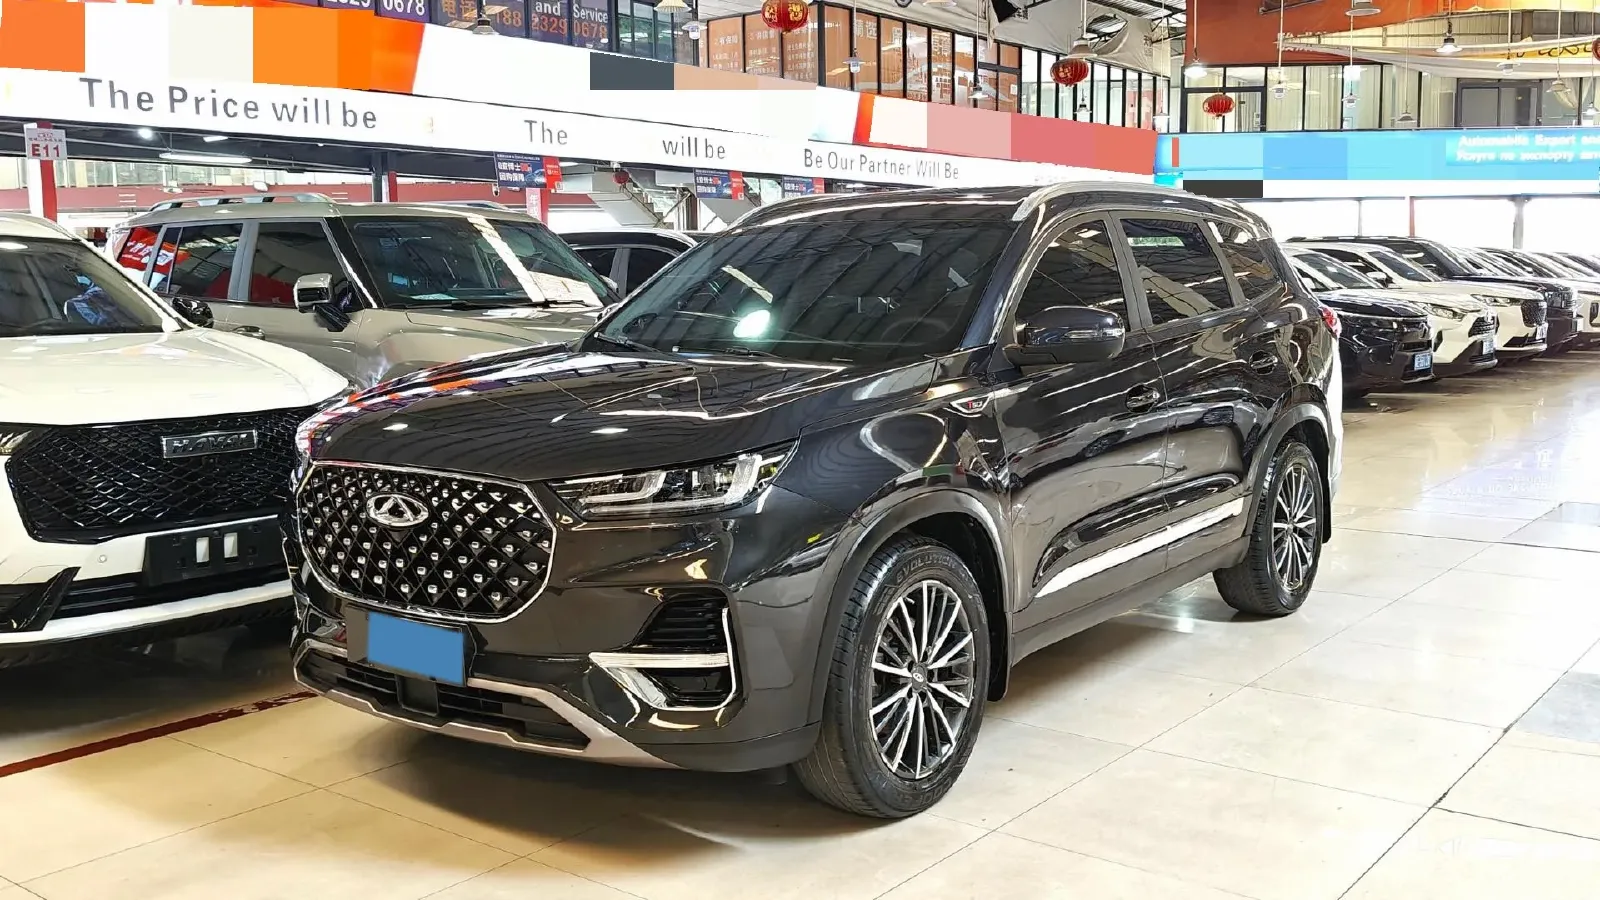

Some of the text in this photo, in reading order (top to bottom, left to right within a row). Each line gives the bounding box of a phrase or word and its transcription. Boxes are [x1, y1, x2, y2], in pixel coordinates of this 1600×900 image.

[532, 13, 568, 36] 2329
[535, 1, 609, 23] and Service
[79, 77, 377, 129] The Price will be
[31, 143, 60, 157] E11
[524, 120, 726, 160] The will be
[804, 148, 959, 180] Be Our Partner Will Be
